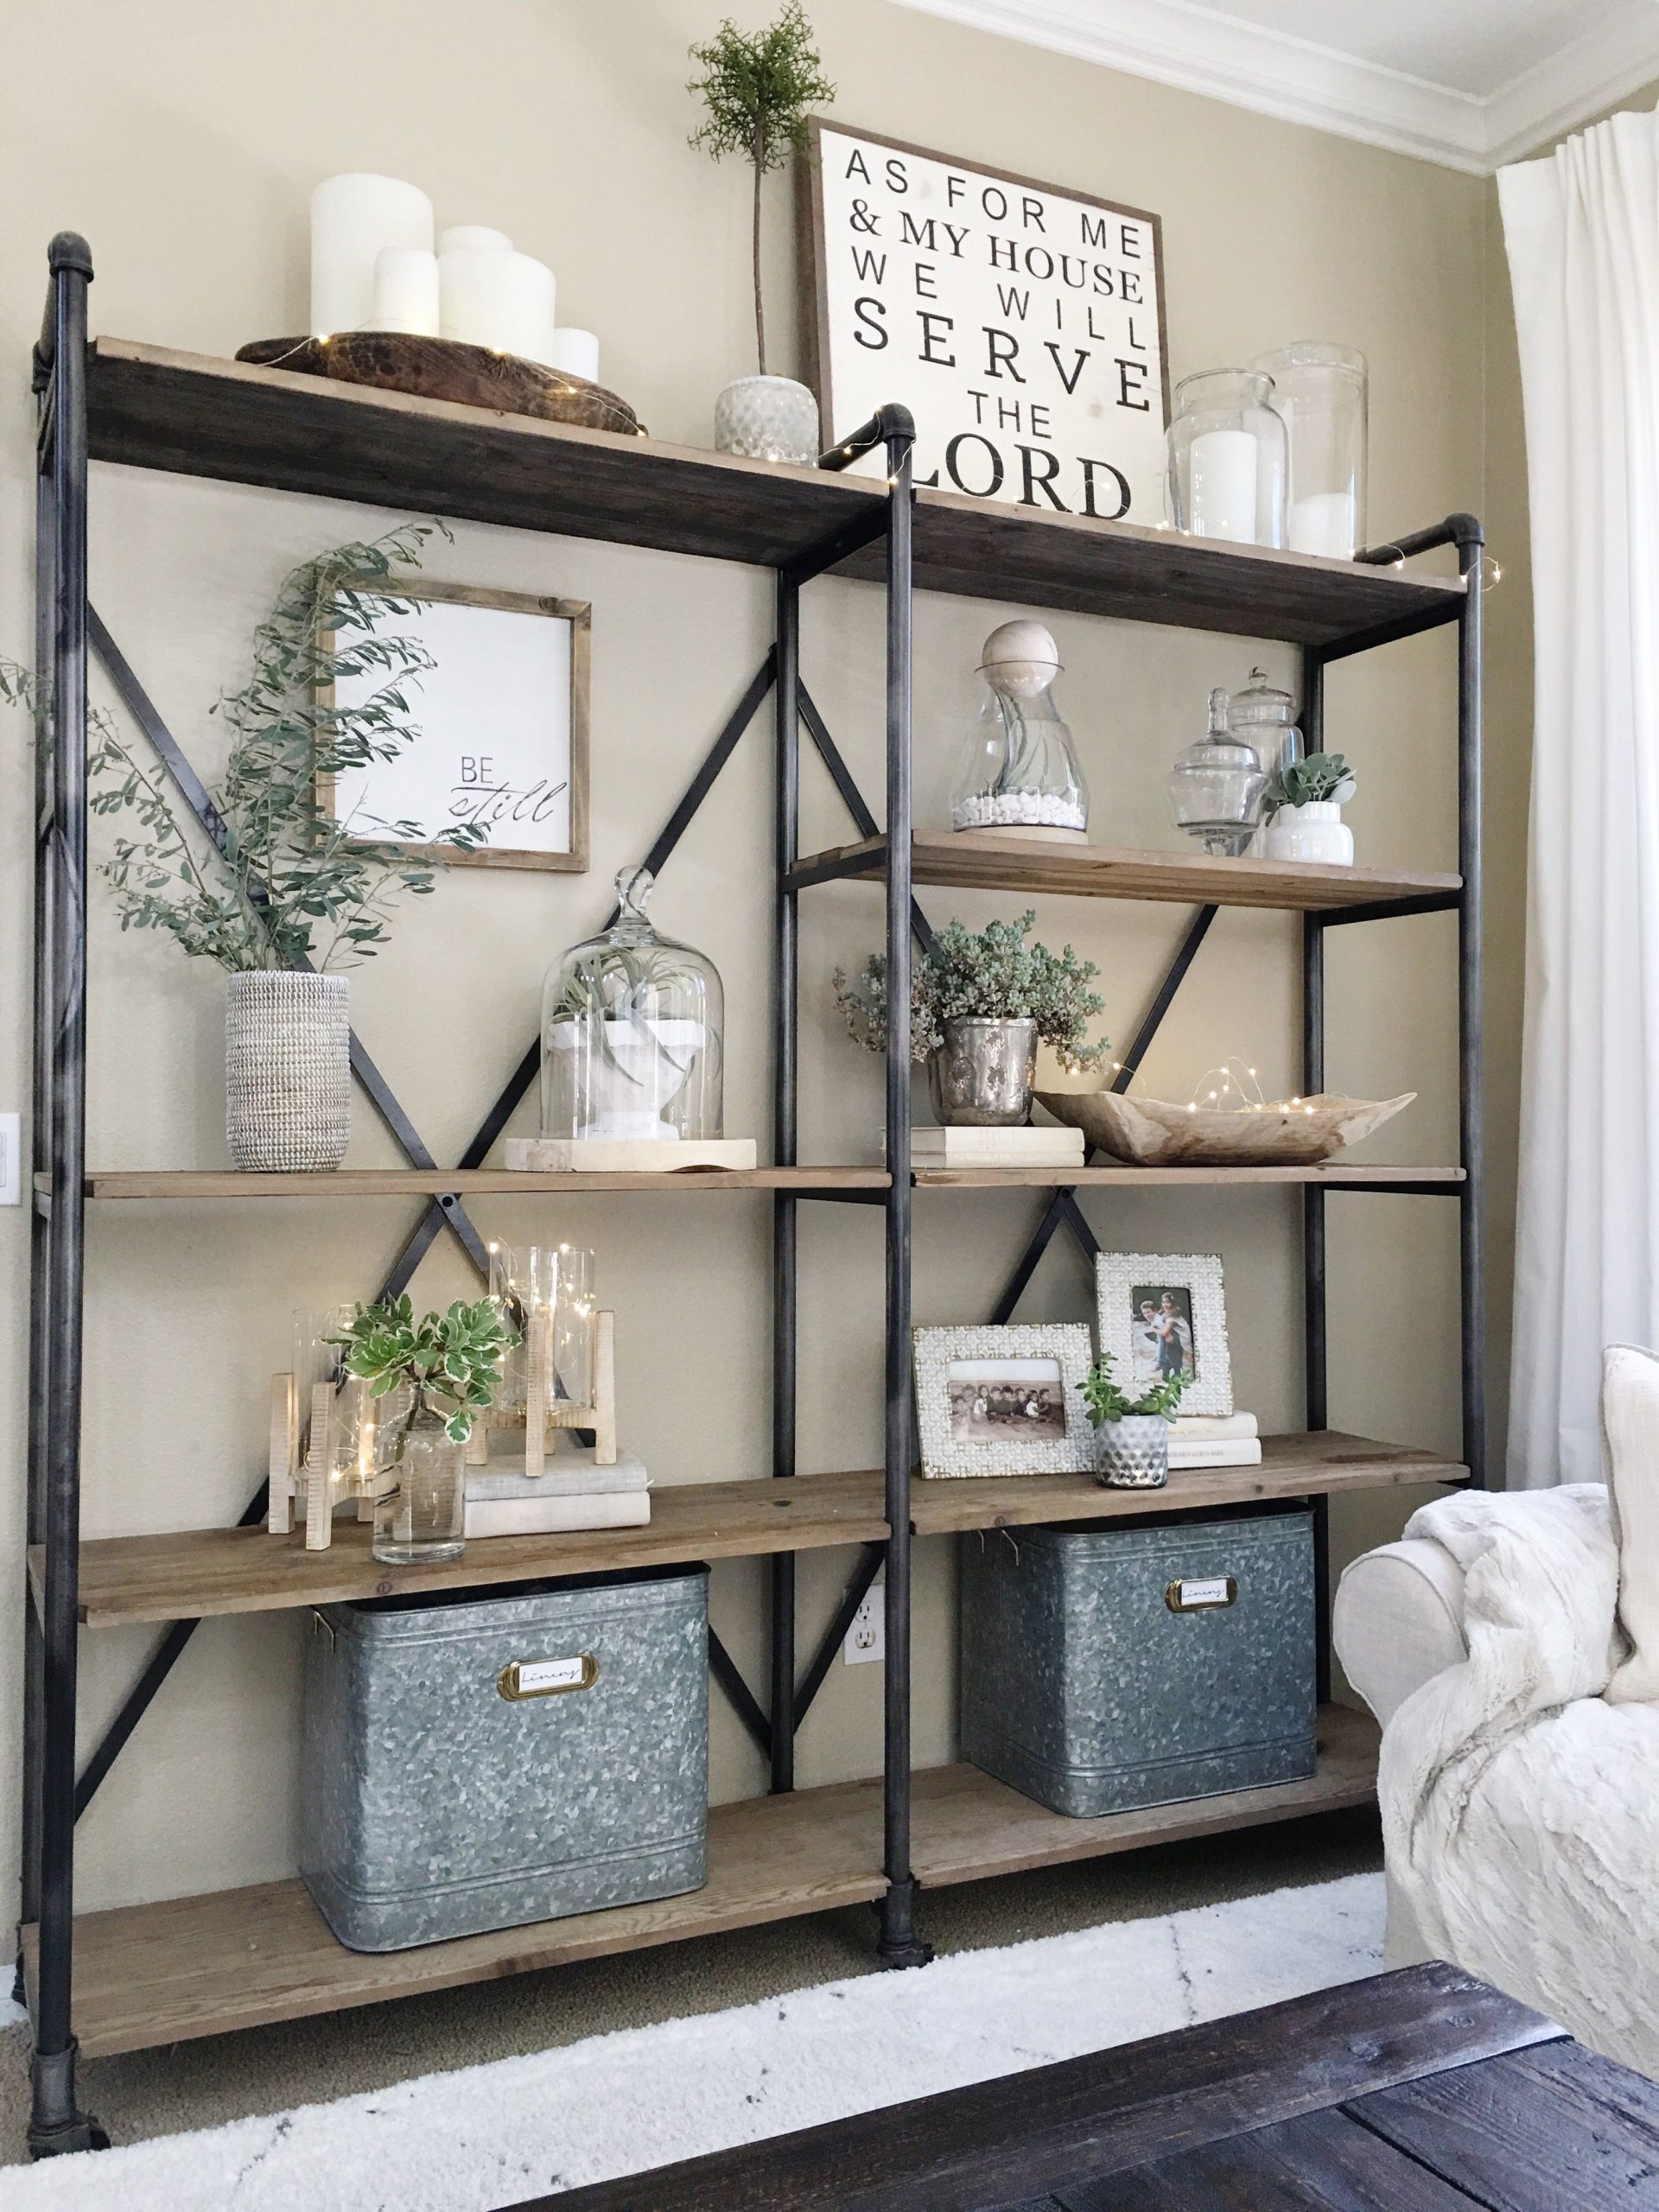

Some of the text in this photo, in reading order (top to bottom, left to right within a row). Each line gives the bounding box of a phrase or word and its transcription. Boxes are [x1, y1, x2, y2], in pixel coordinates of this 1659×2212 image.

[844, 149, 1141, 259] AS FOR ME
[849, 198, 1144, 305] & MY HOUSE
[850, 245, 1147, 351] WE WILL
[853, 296, 1150, 412] SERVE
[966, 389, 1053, 440] THE
[911, 432, 1132, 520] ORD
[461, 755, 494, 785] BE
